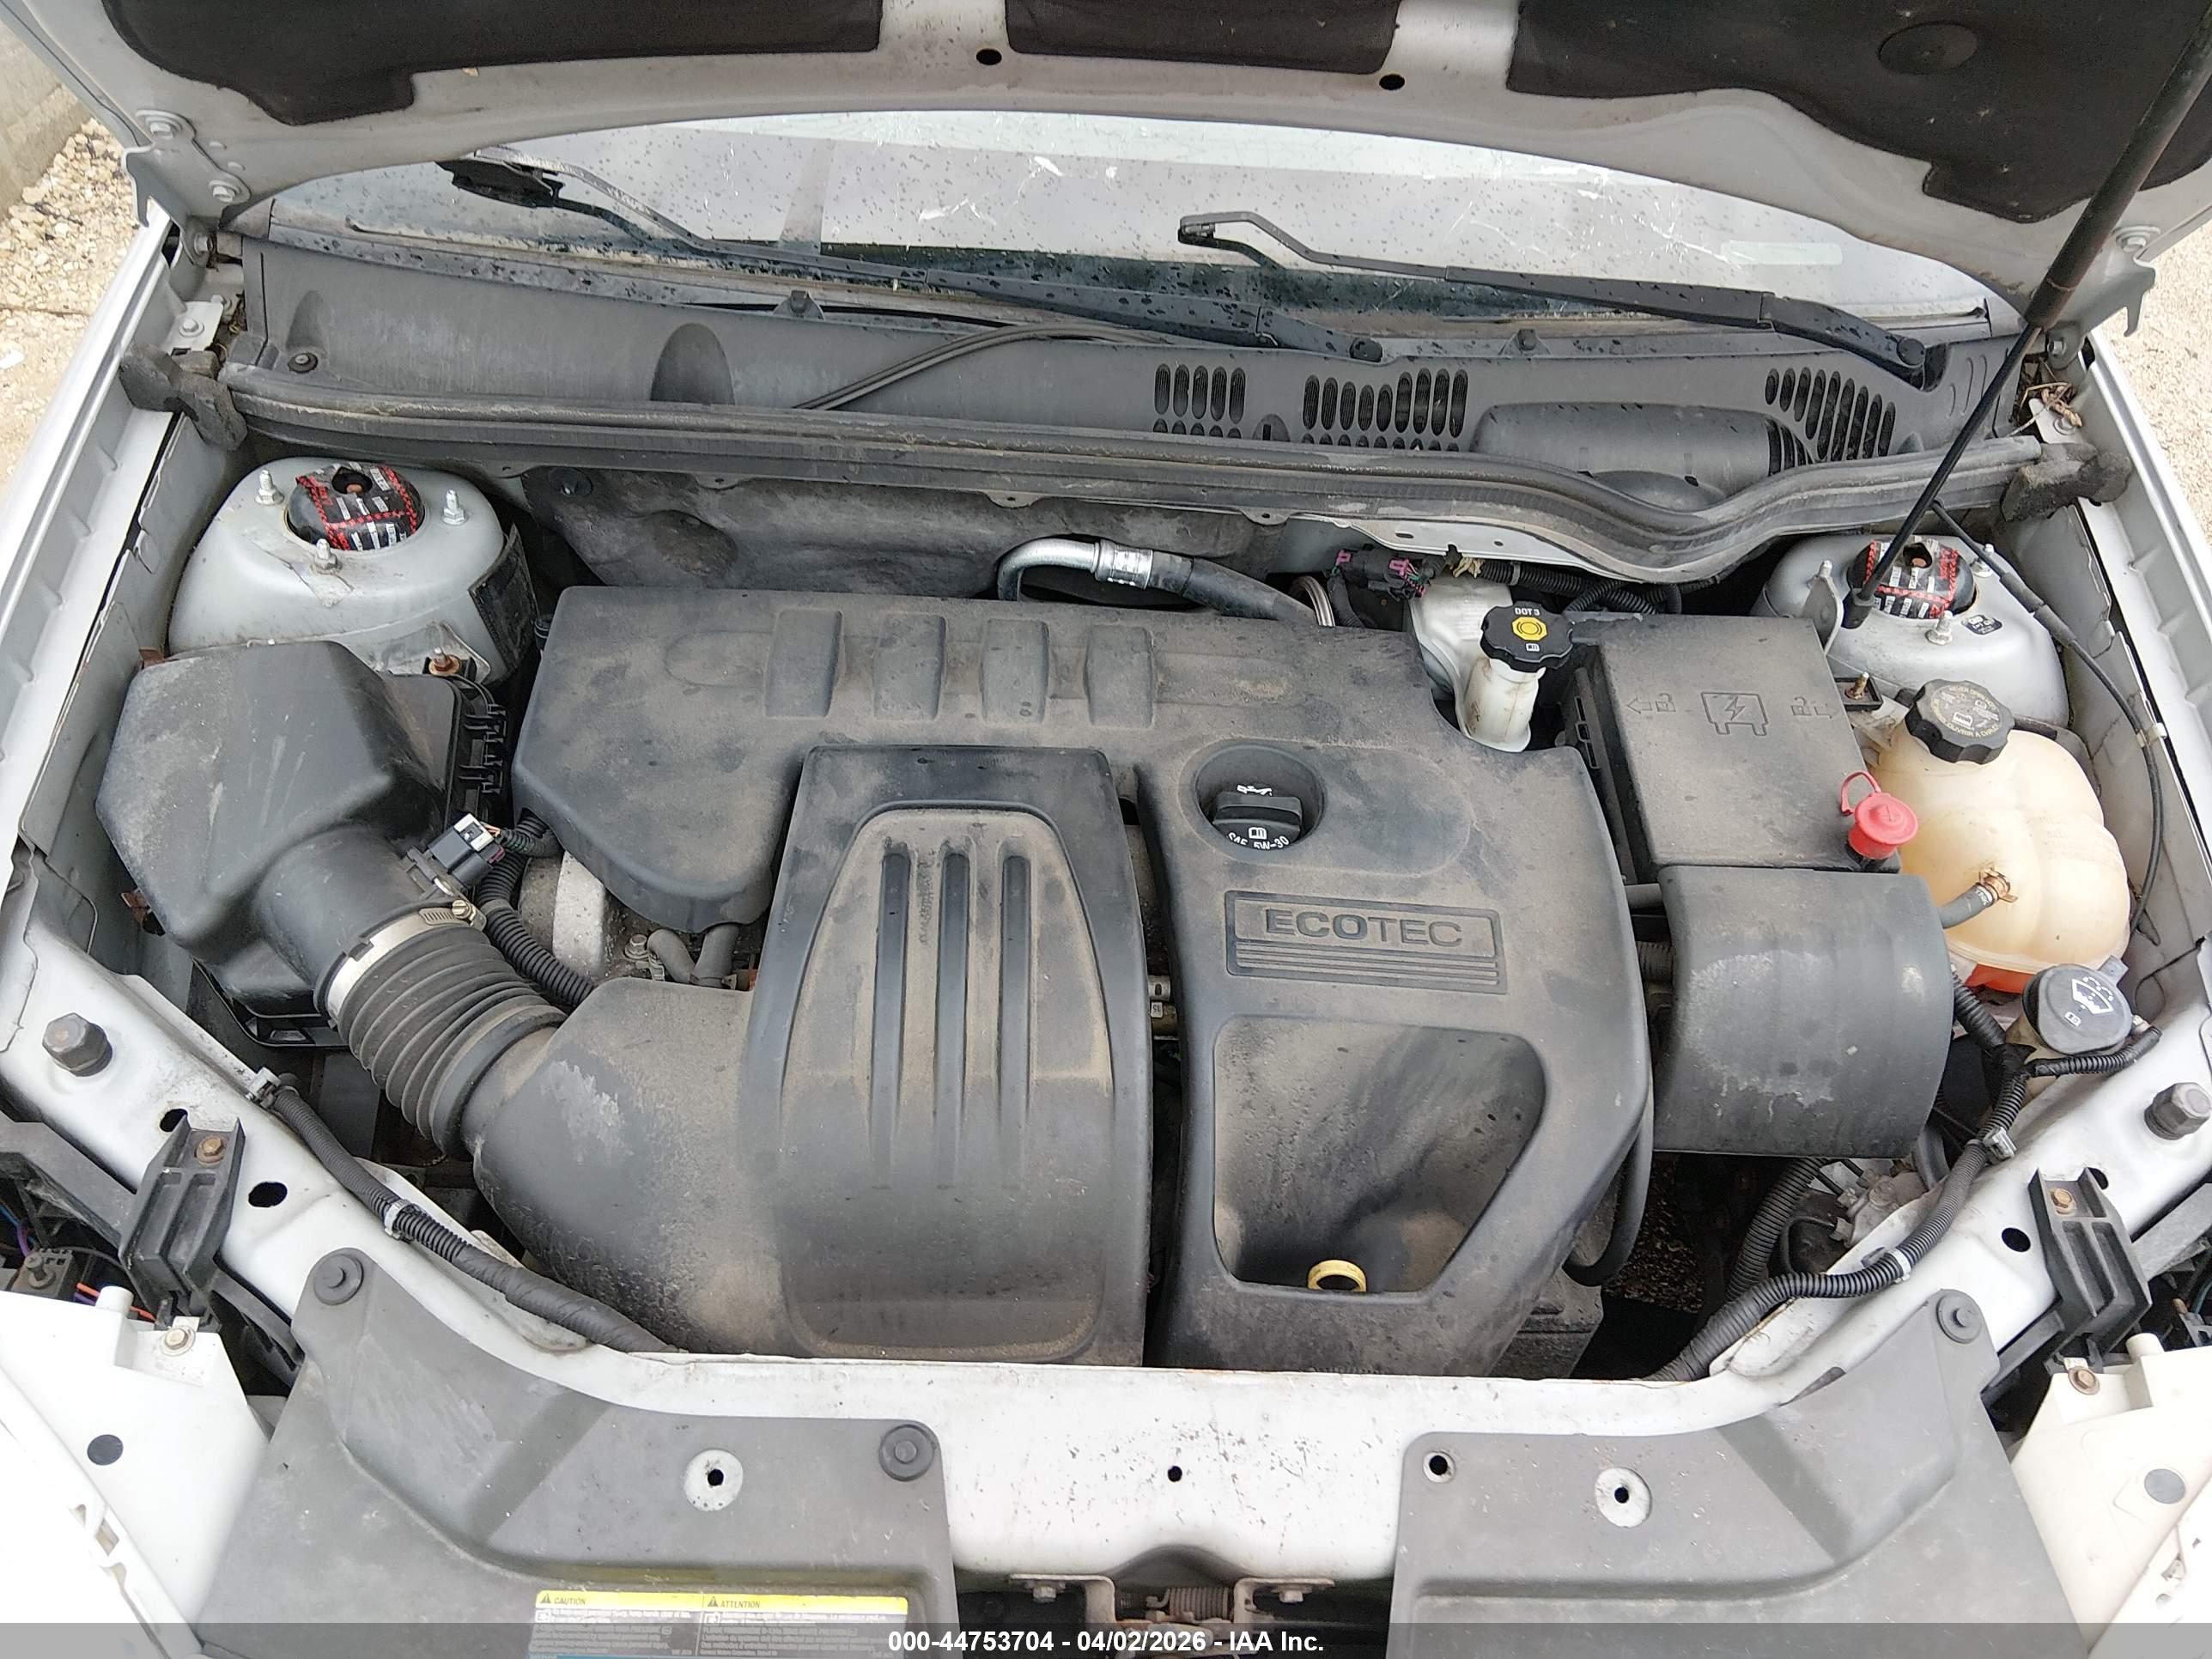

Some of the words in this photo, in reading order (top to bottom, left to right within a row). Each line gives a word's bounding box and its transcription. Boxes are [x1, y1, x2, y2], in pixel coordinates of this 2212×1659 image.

[1514, 607, 1533, 616] DOT
[1534, 608, 1540, 617] 3
[1266, 908, 1463, 948] ECOTEC
[554, 1596, 586, 1606] CAUTION
[720, 1600, 761, 1608] ATTENTION
